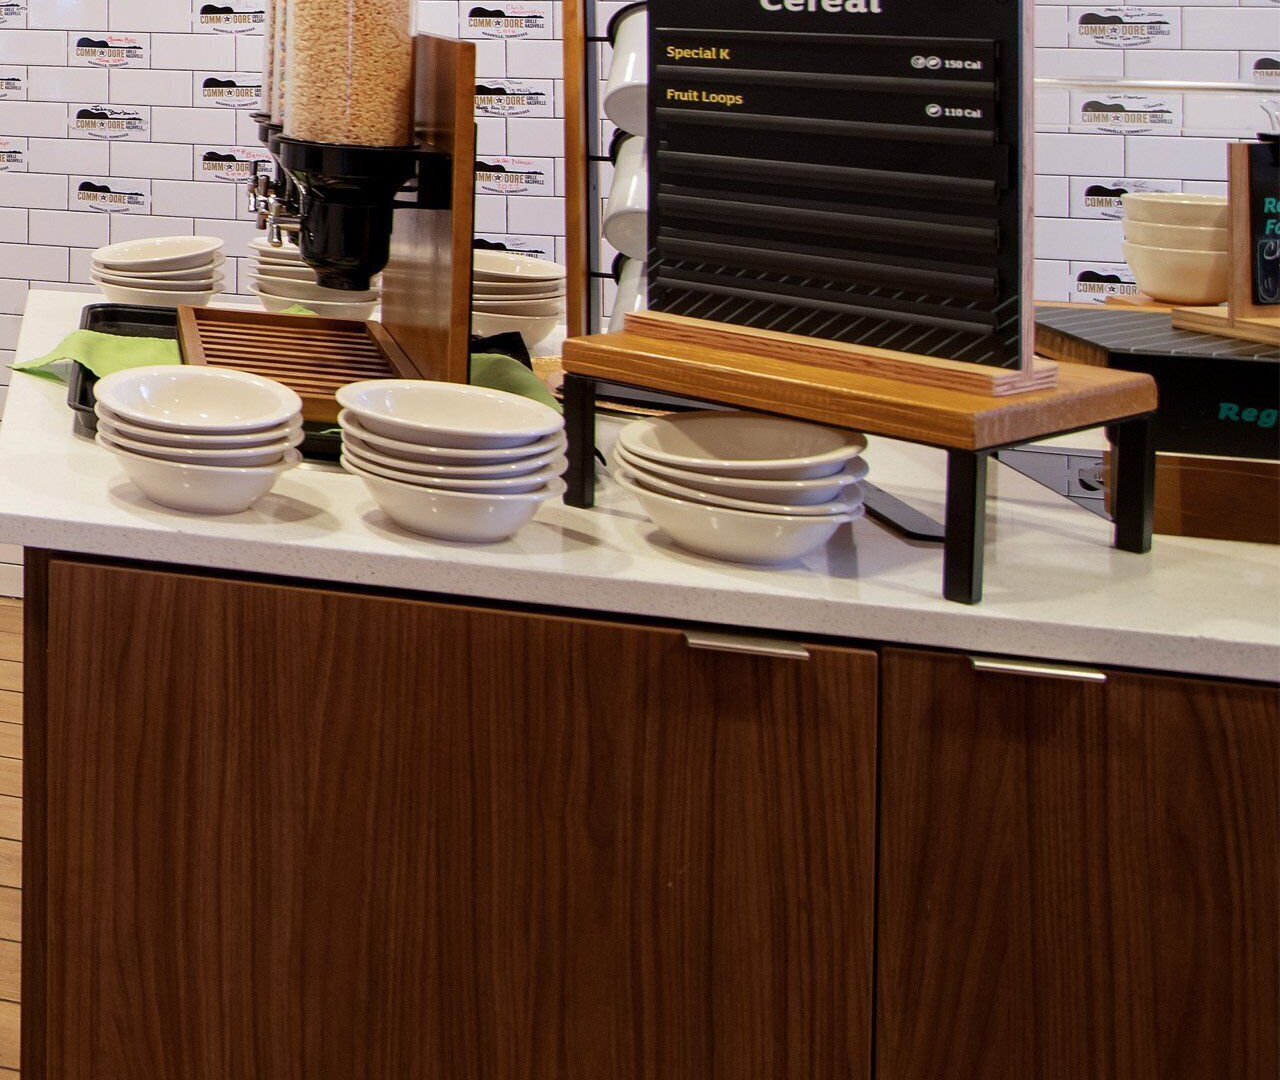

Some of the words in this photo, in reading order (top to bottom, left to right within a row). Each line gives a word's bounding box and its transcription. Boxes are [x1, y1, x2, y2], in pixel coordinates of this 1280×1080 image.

[666, 45, 717, 61] Special
[718, 49, 730, 60] K
[964, 60, 981, 69] Cal
[666, 88, 700, 104] Fruit
[702, 91, 743, 106] Loops
[944, 108, 963, 117] 110
[964, 108, 981, 118] Cal
